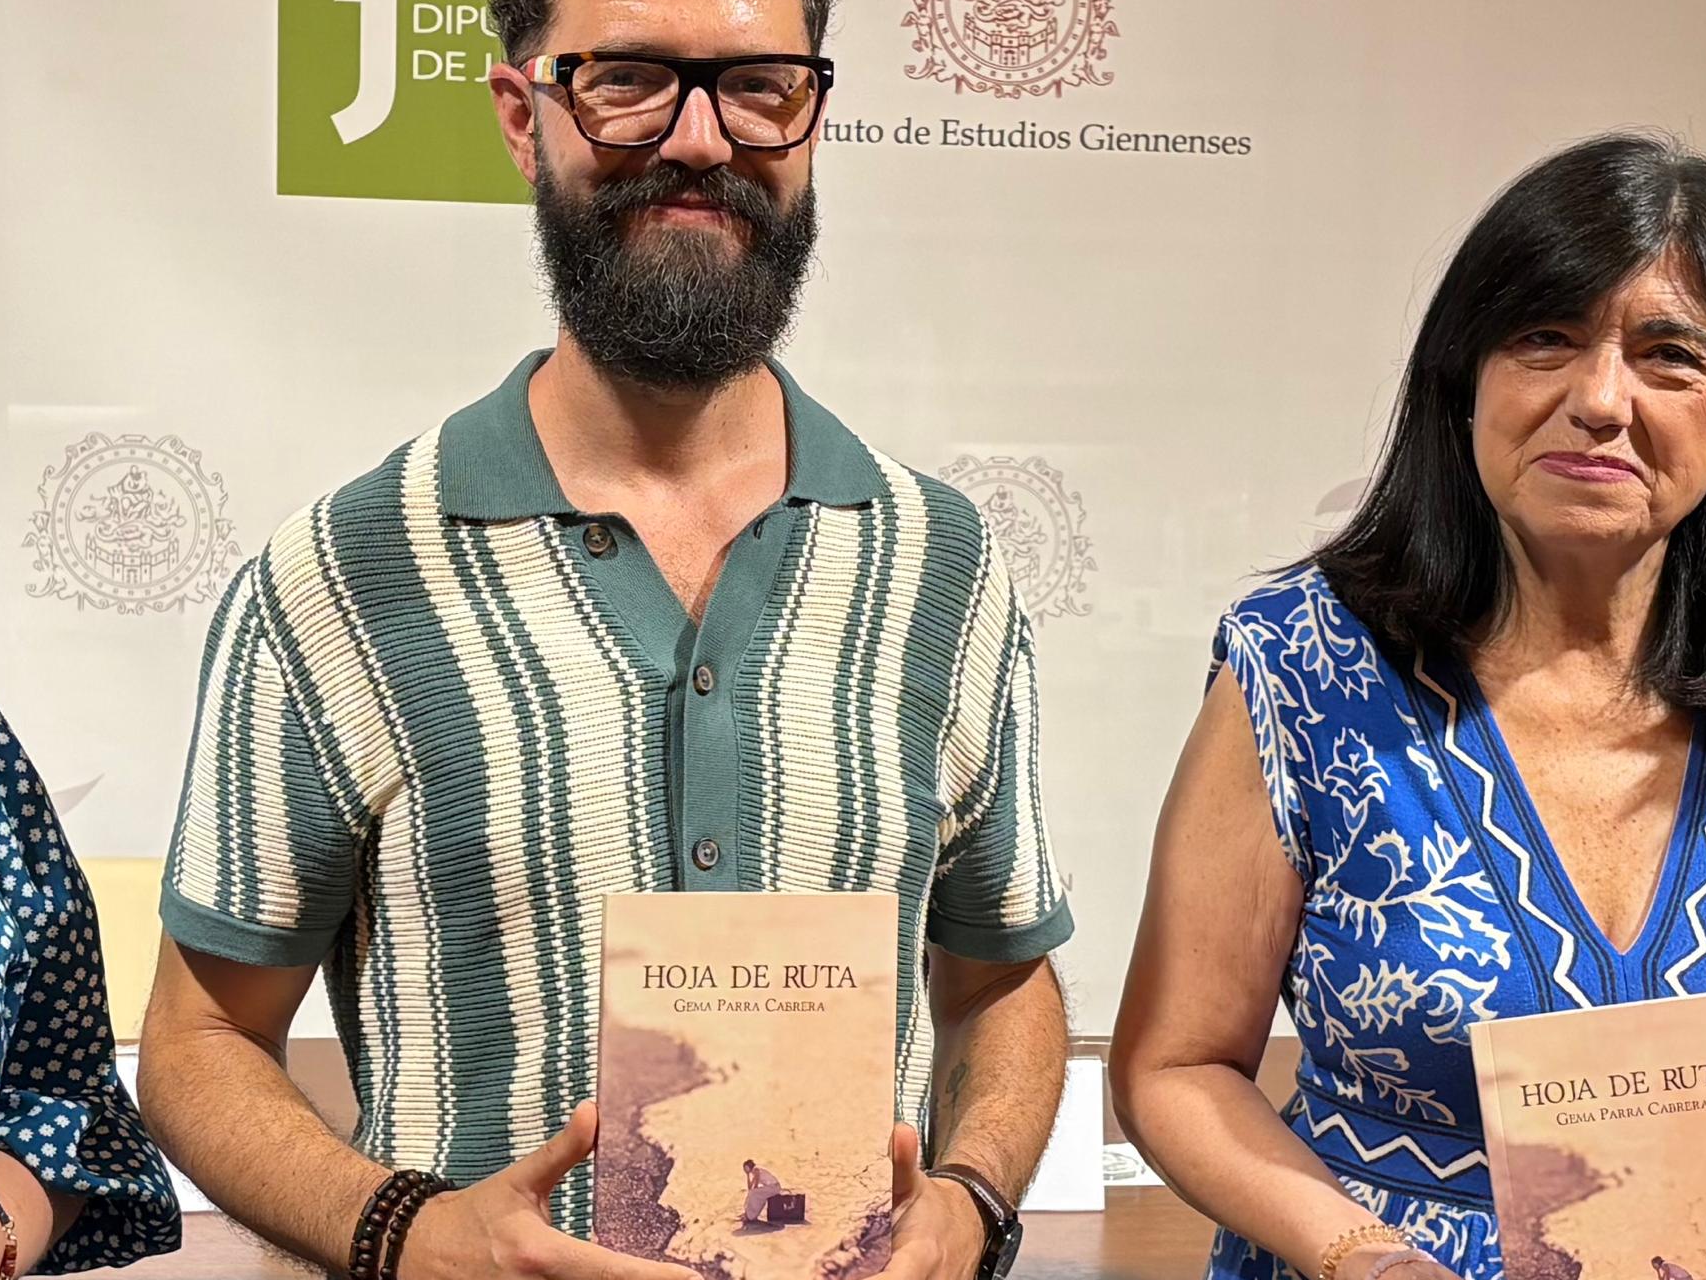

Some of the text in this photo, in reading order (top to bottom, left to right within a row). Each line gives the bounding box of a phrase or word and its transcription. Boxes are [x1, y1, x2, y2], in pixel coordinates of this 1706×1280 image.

[413, 49, 466, 81] DE
[894, 117, 930, 145] de
[941, 119, 1071, 149] Estudios
[1080, 124, 1251, 155] Giennenses
[643, 965, 857, 989] HOJA DE RUTA
[1520, 1078, 1597, 1107] HOJA
[1608, 1071, 1649, 1097] DE
